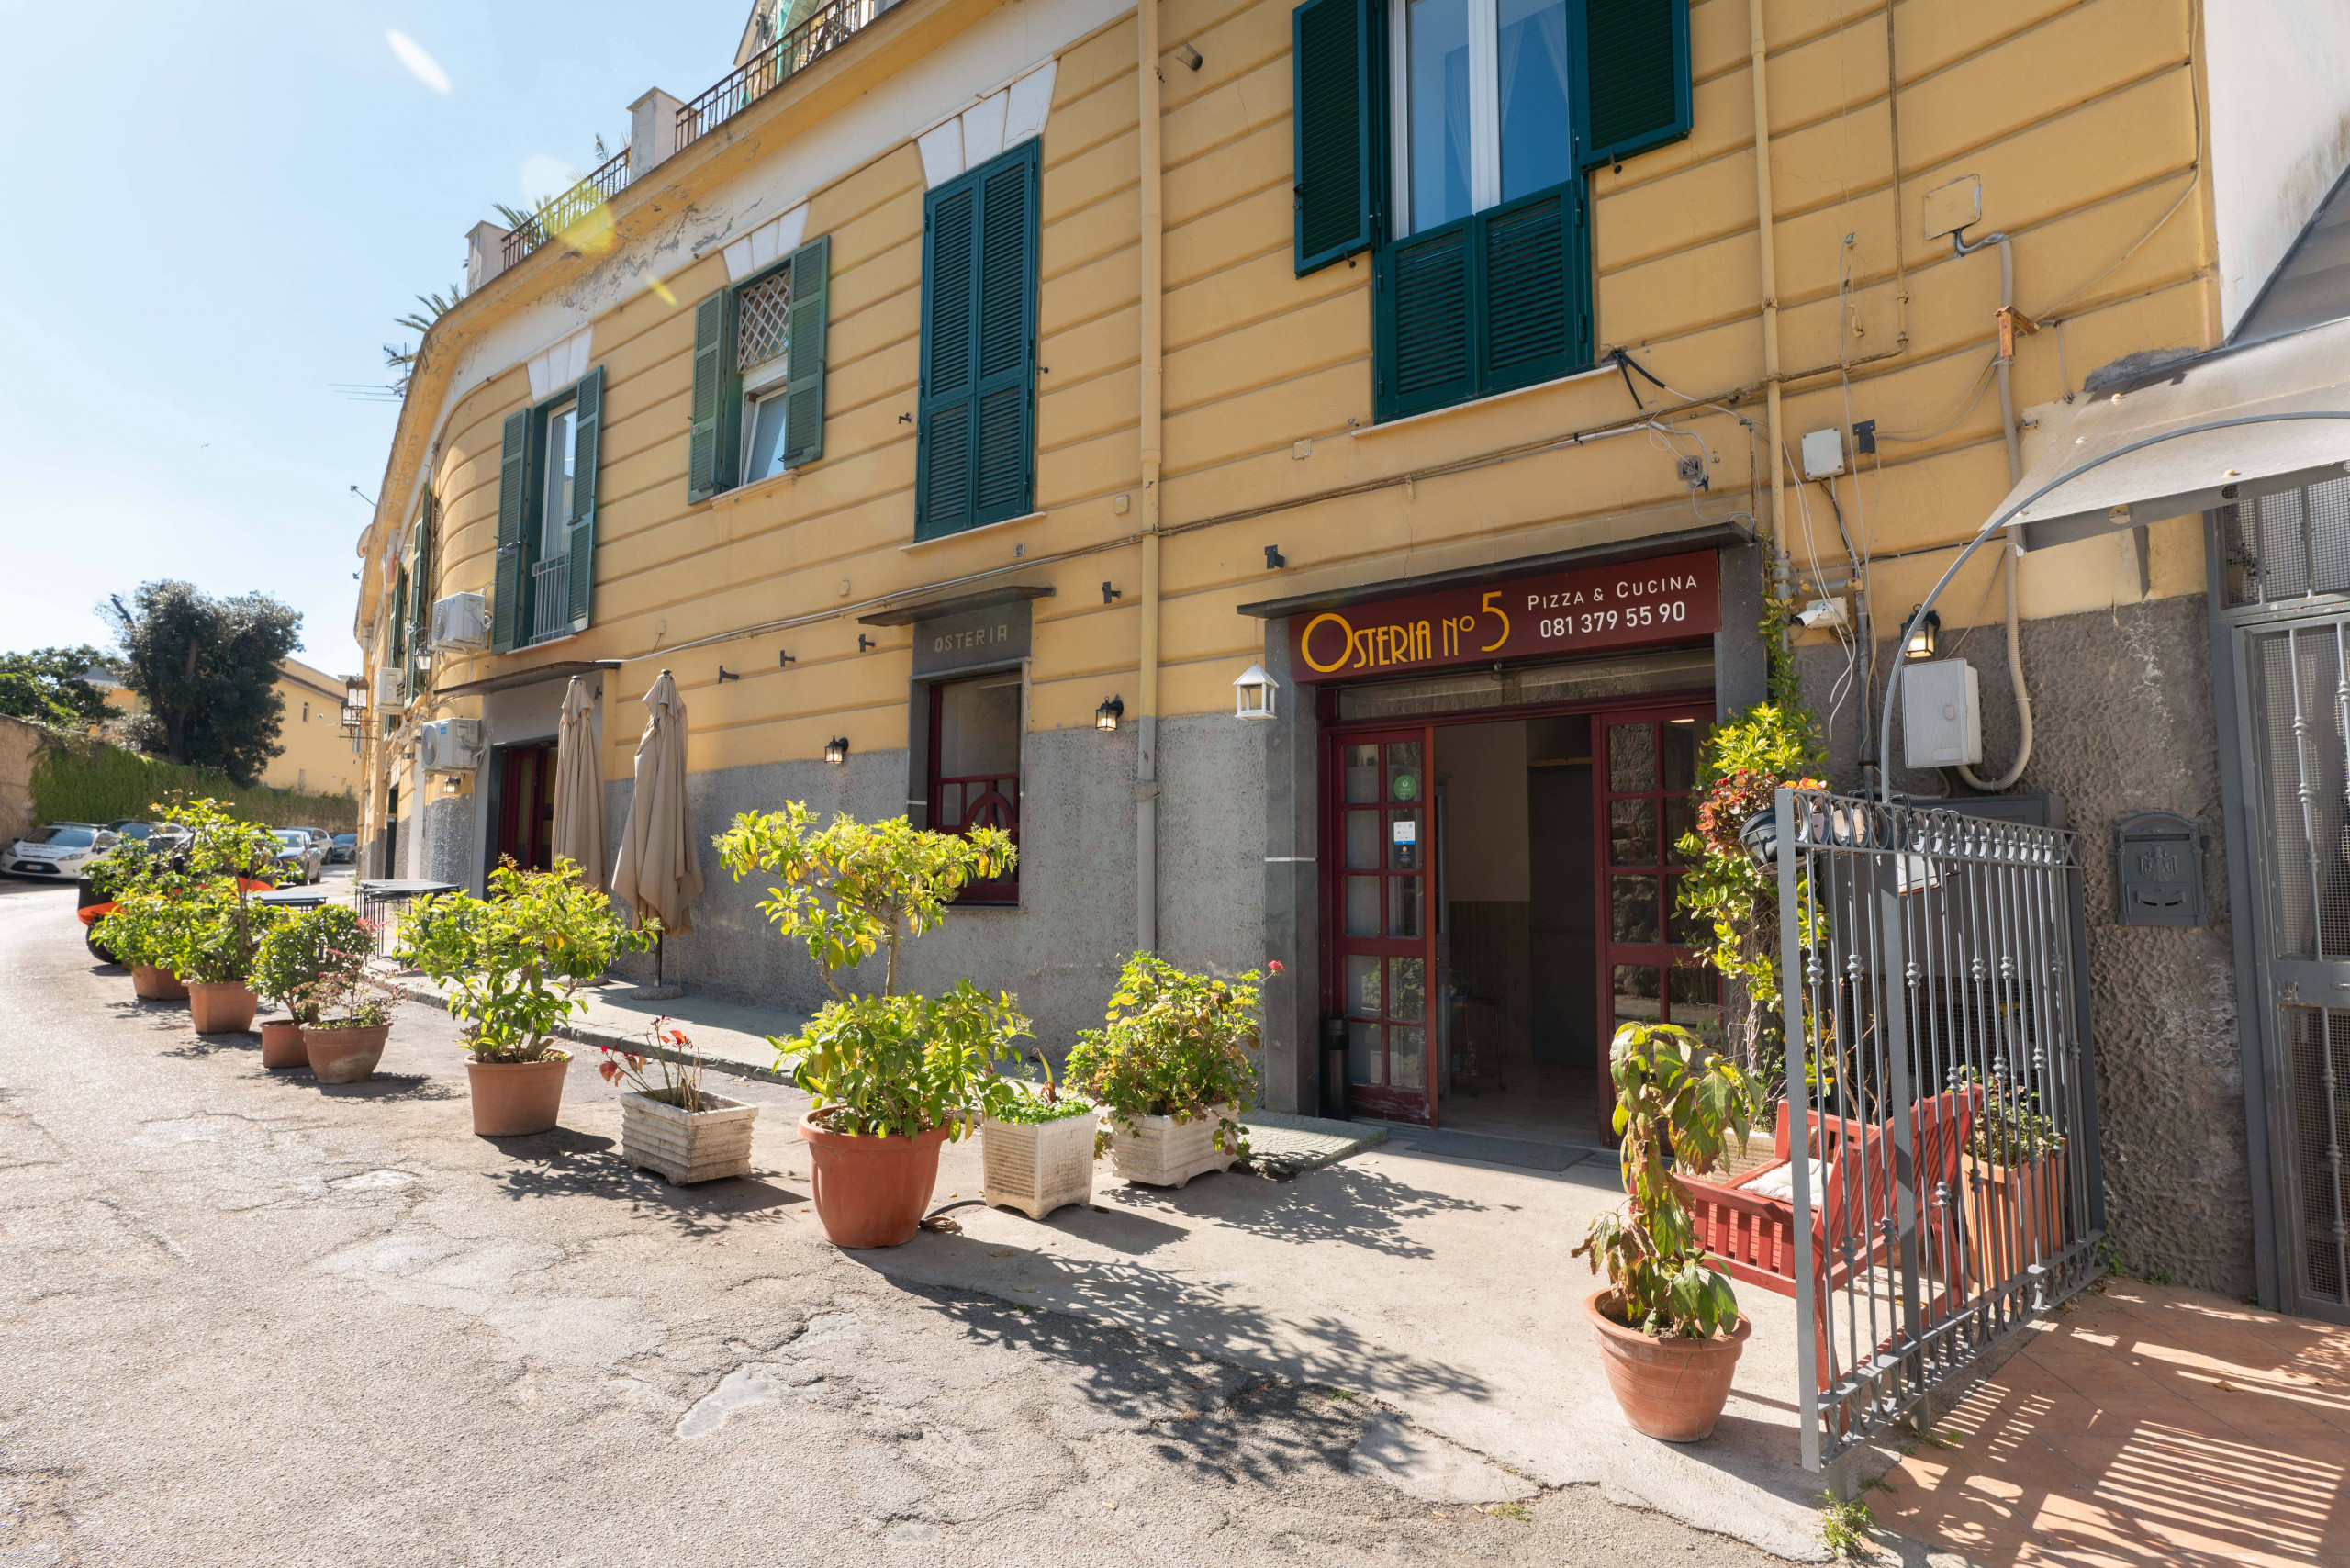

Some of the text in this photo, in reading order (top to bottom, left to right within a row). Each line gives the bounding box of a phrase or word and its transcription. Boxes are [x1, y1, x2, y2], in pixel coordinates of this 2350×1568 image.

[1528, 575, 1697, 610] PIZZA & CUCINA
[1301, 612, 1432, 672] OSTERIA
[1481, 590, 1510, 652] 5
[1539, 601, 1685, 638] 081 379 55 90
[934, 624, 1007, 653] OSTERIA
